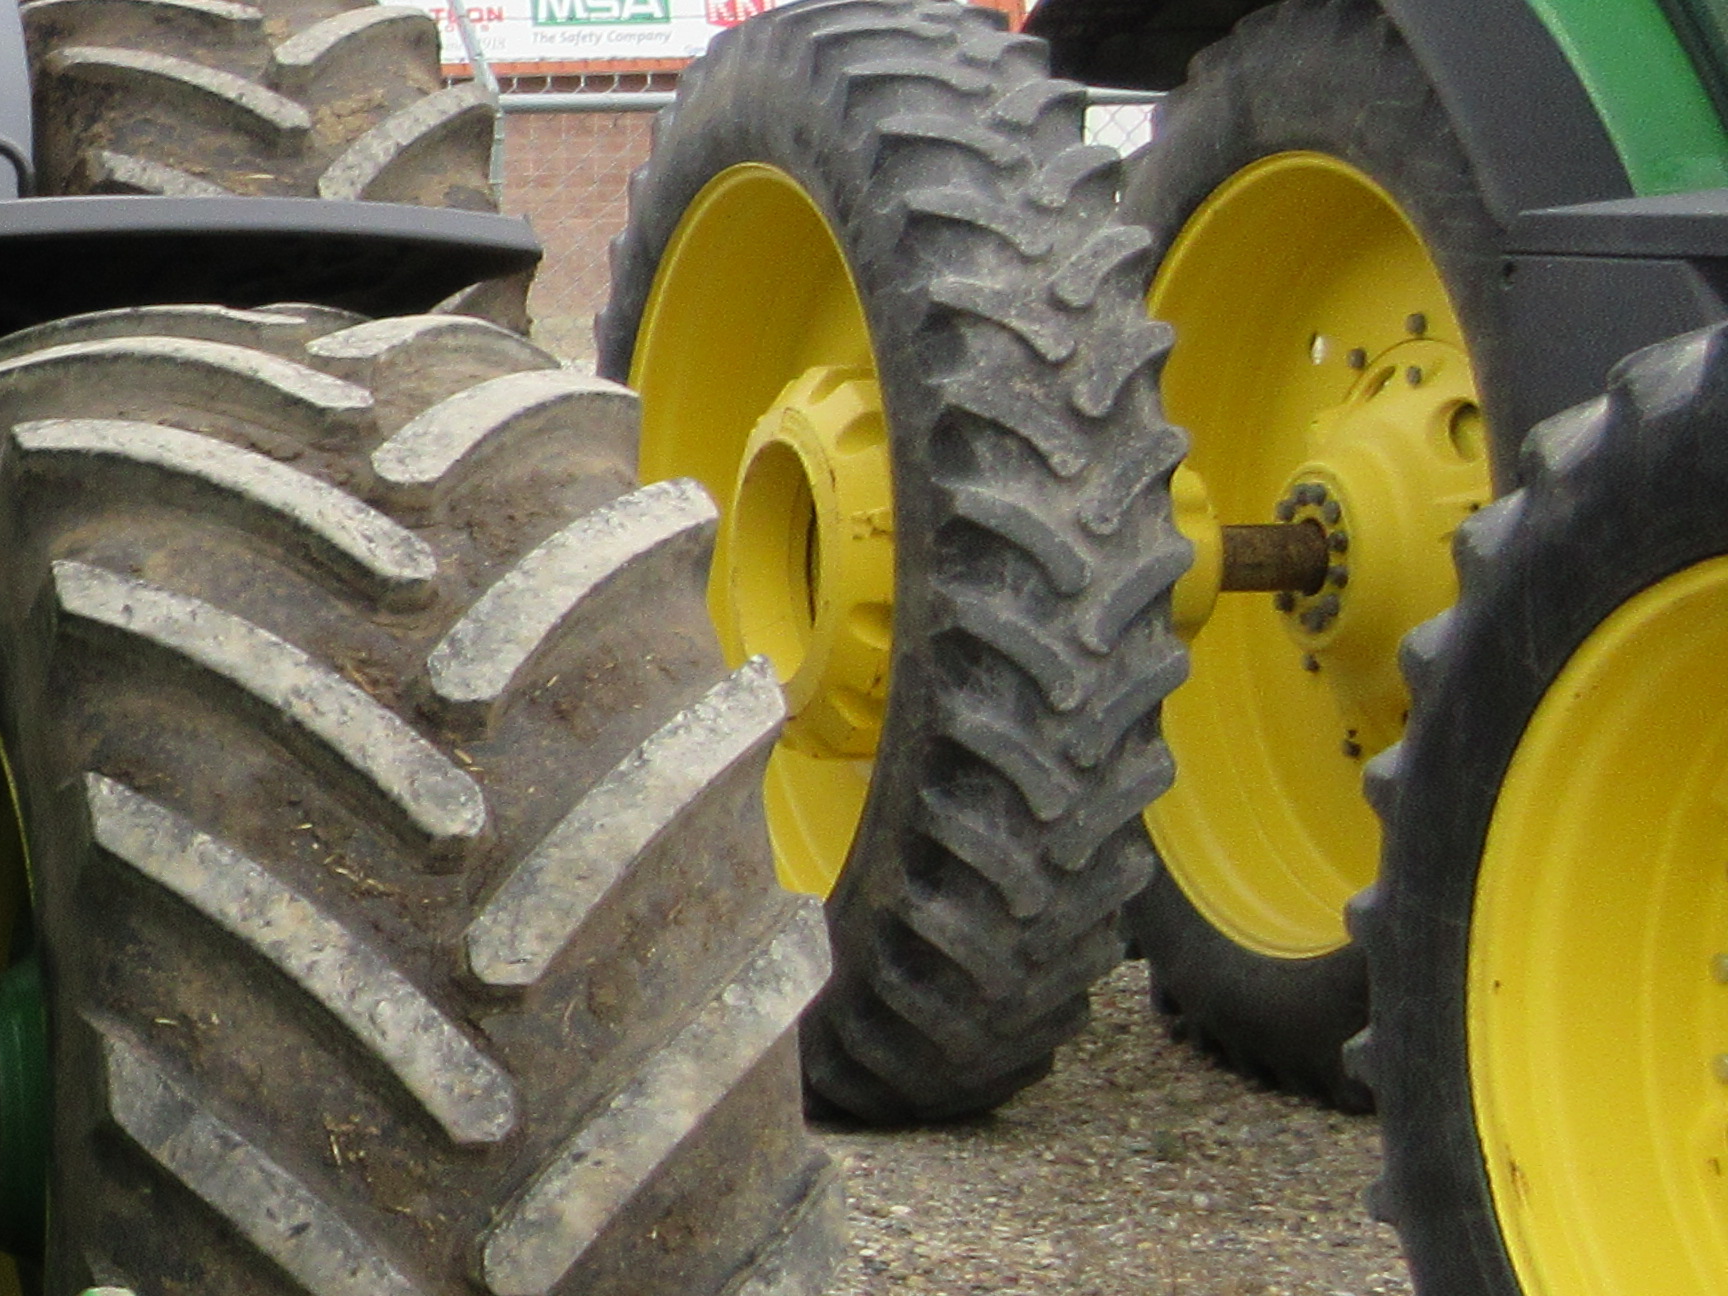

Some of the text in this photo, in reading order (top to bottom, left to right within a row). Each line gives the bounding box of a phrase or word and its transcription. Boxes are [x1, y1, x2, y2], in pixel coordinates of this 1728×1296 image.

[533, 29, 672, 46] The Safety Company
